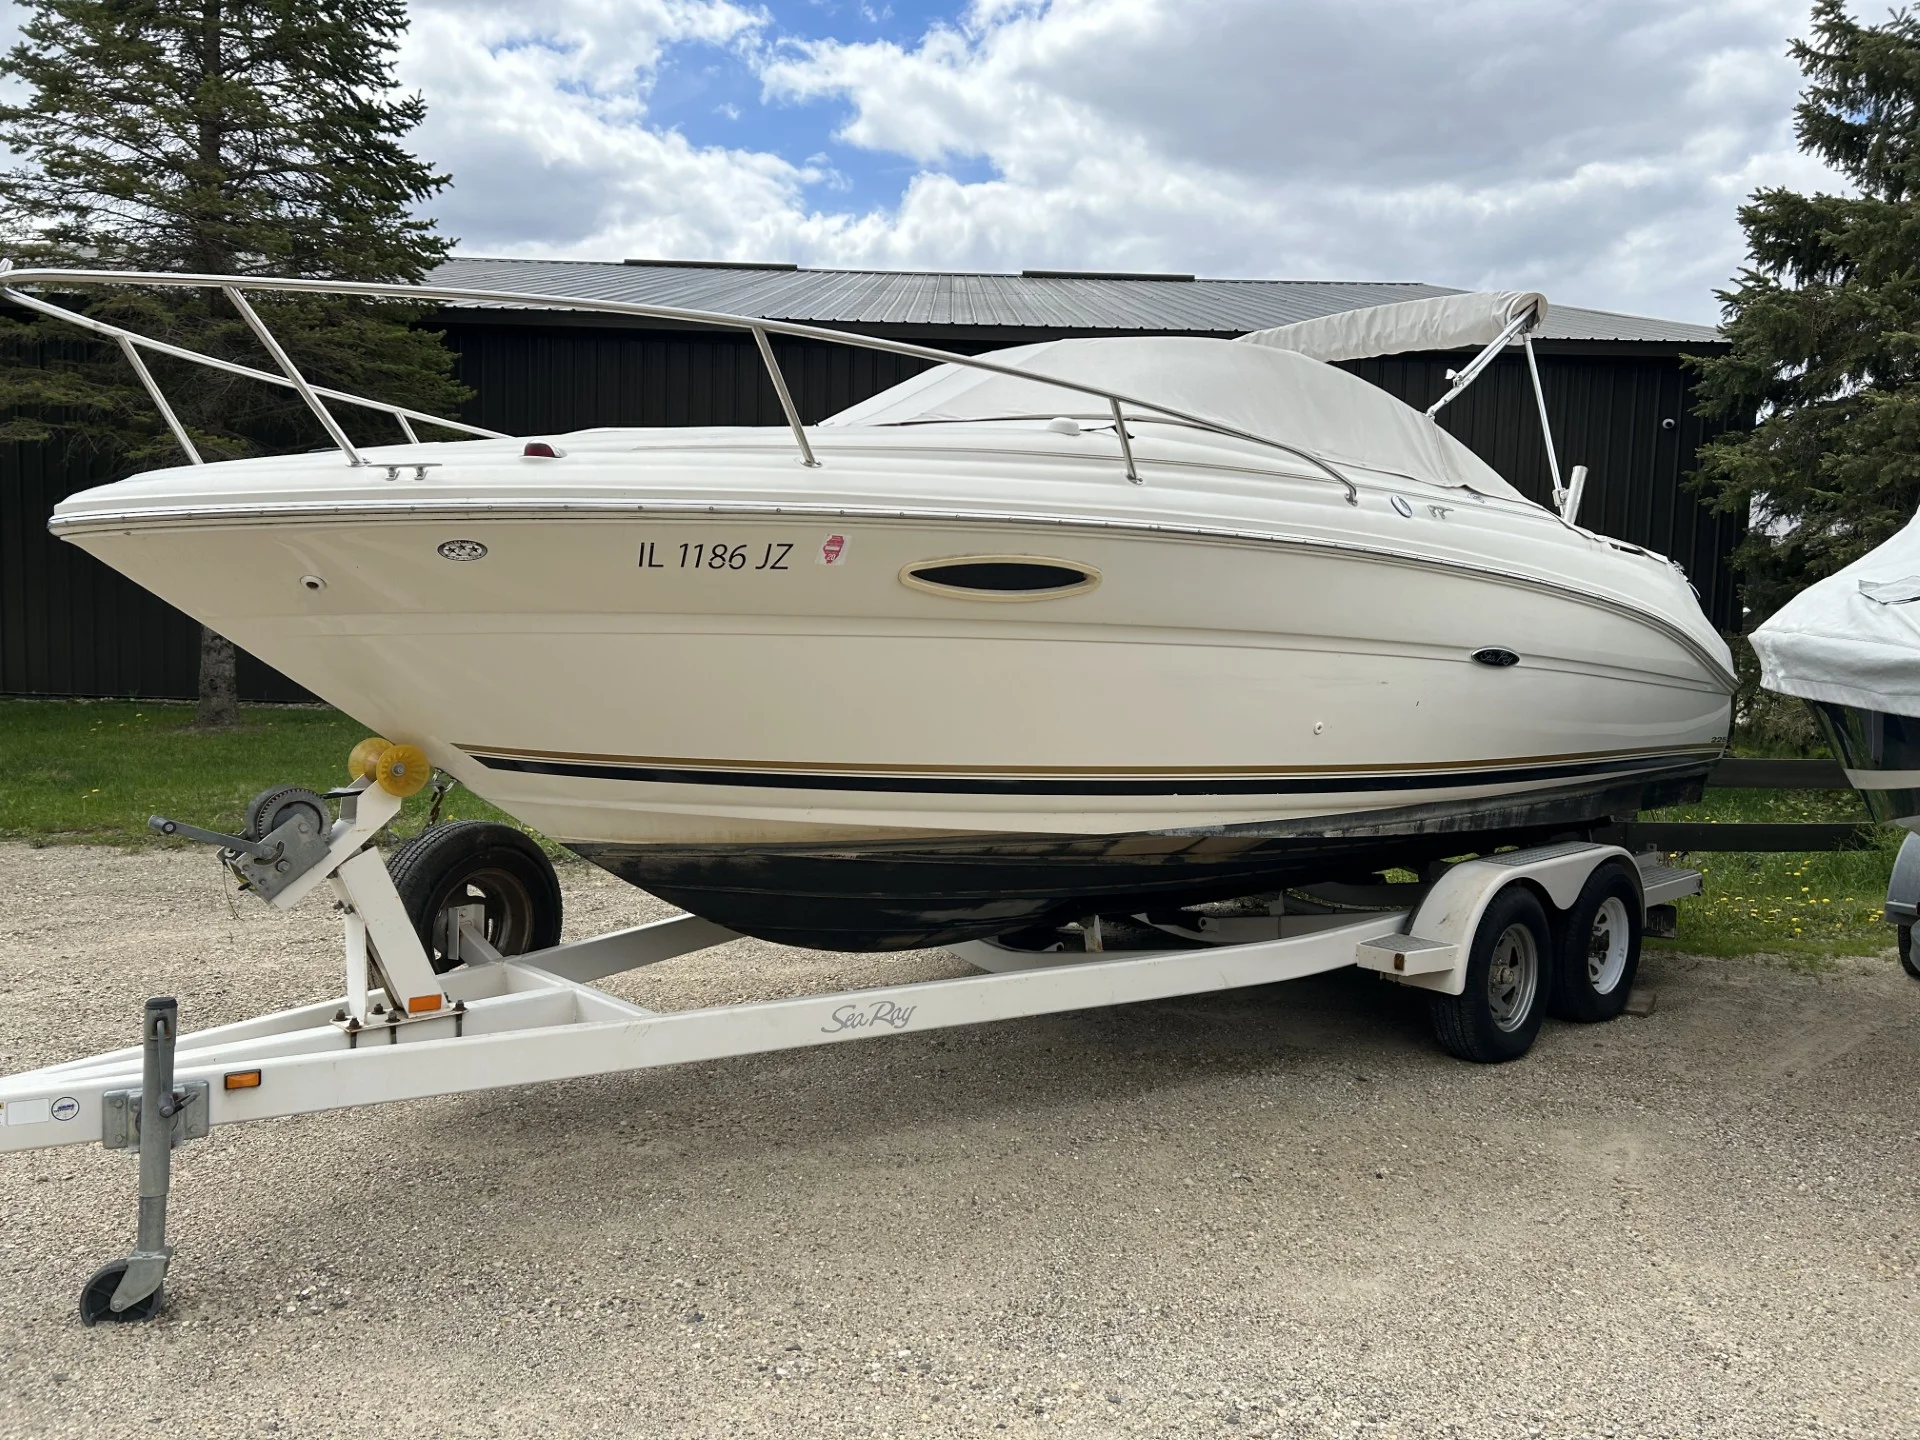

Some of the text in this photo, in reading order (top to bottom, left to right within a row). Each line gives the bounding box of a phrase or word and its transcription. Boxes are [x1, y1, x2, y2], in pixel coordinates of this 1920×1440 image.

[638, 542, 794, 570] IL 1186 JZ
[820, 1001, 917, 1033] Sea Ray
